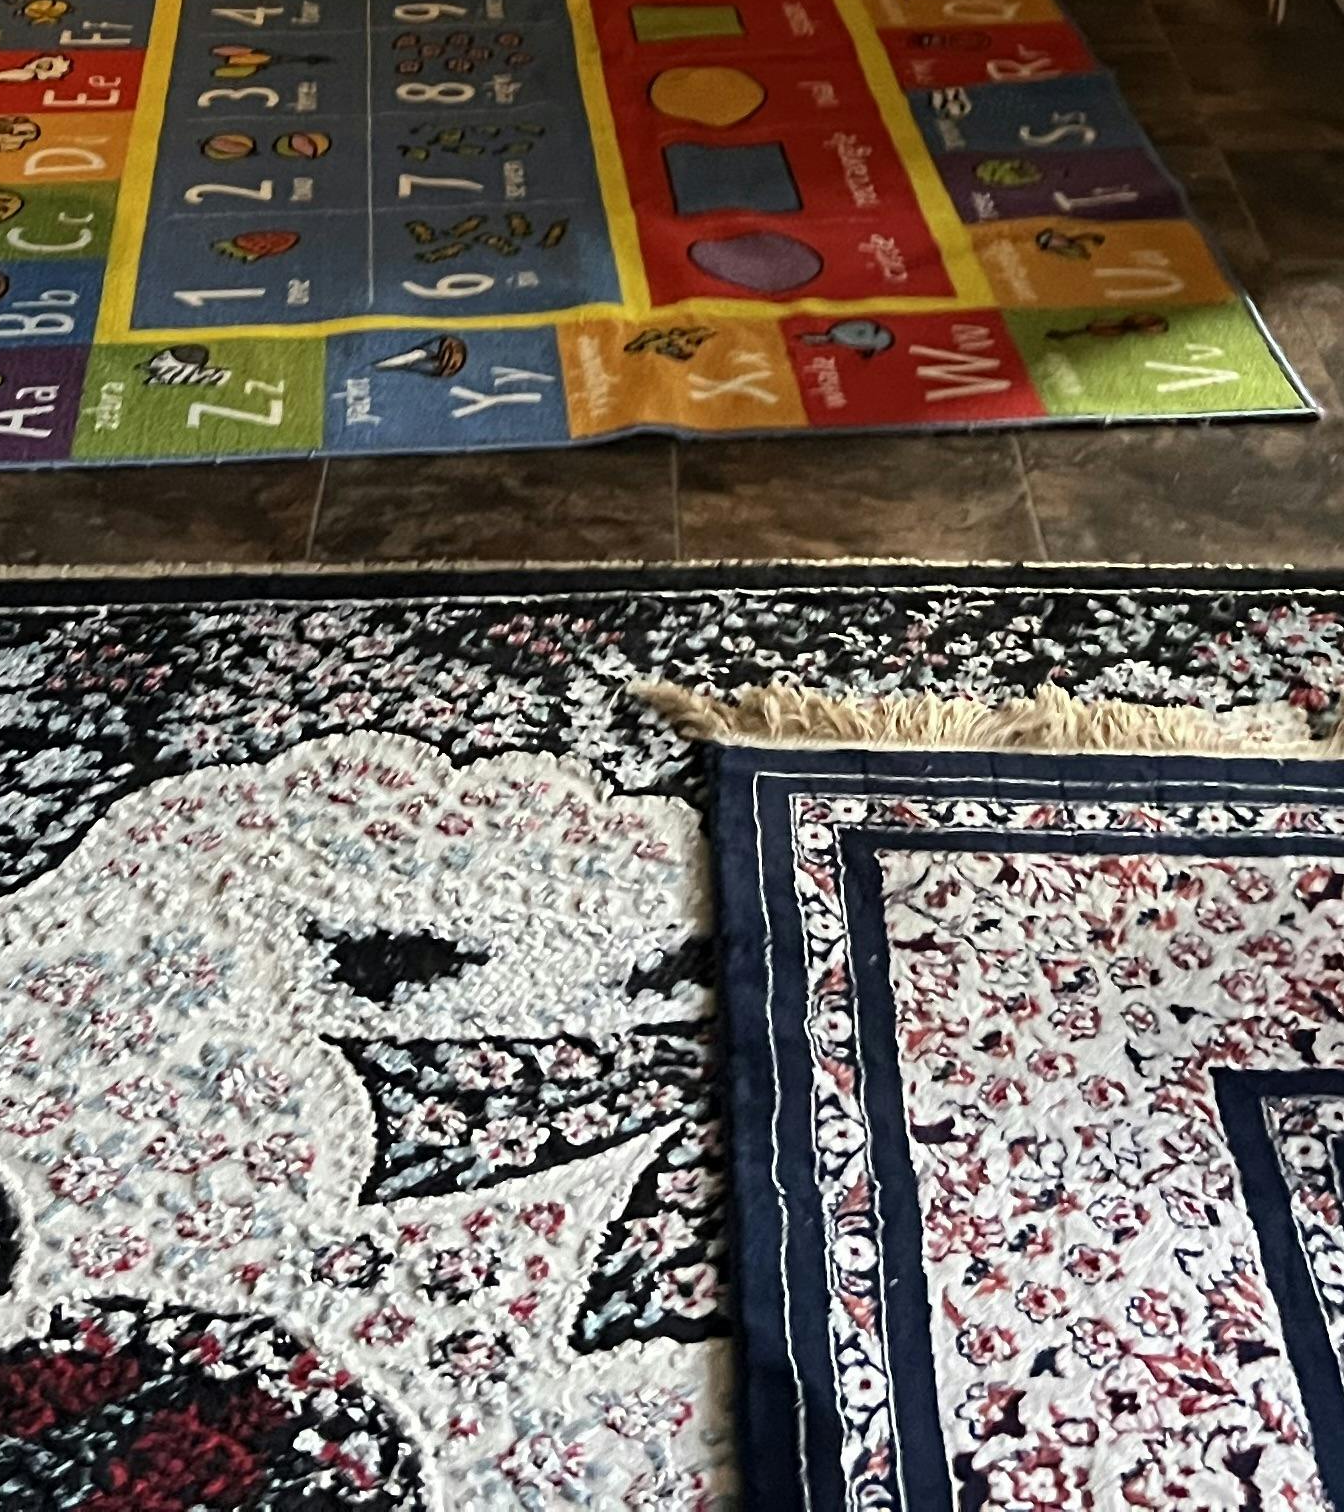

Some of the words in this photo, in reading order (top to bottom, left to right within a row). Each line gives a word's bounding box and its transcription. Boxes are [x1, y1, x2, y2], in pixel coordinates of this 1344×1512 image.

[210, 6, 285, 28] 4
[393, 2, 469, 24] 9
[59, 19, 135, 47] Ff
[43, 74, 122, 107] Ee
[196, 87, 281, 108] 3
[395, 81, 476, 104] 8
[183, 179, 274, 206] 2
[398, 173, 486, 200] 7
[6, 210, 96, 253] Cc
[173, 287, 266, 307] 1
[400, 272, 496, 299] 6
[909, 322, 1013, 403] Ww
[1144, 343, 1243, 392] Vv
[449, 365, 557, 420] Yy
[805, 354, 850, 409] whale
[186, 379, 285, 431] Zz
